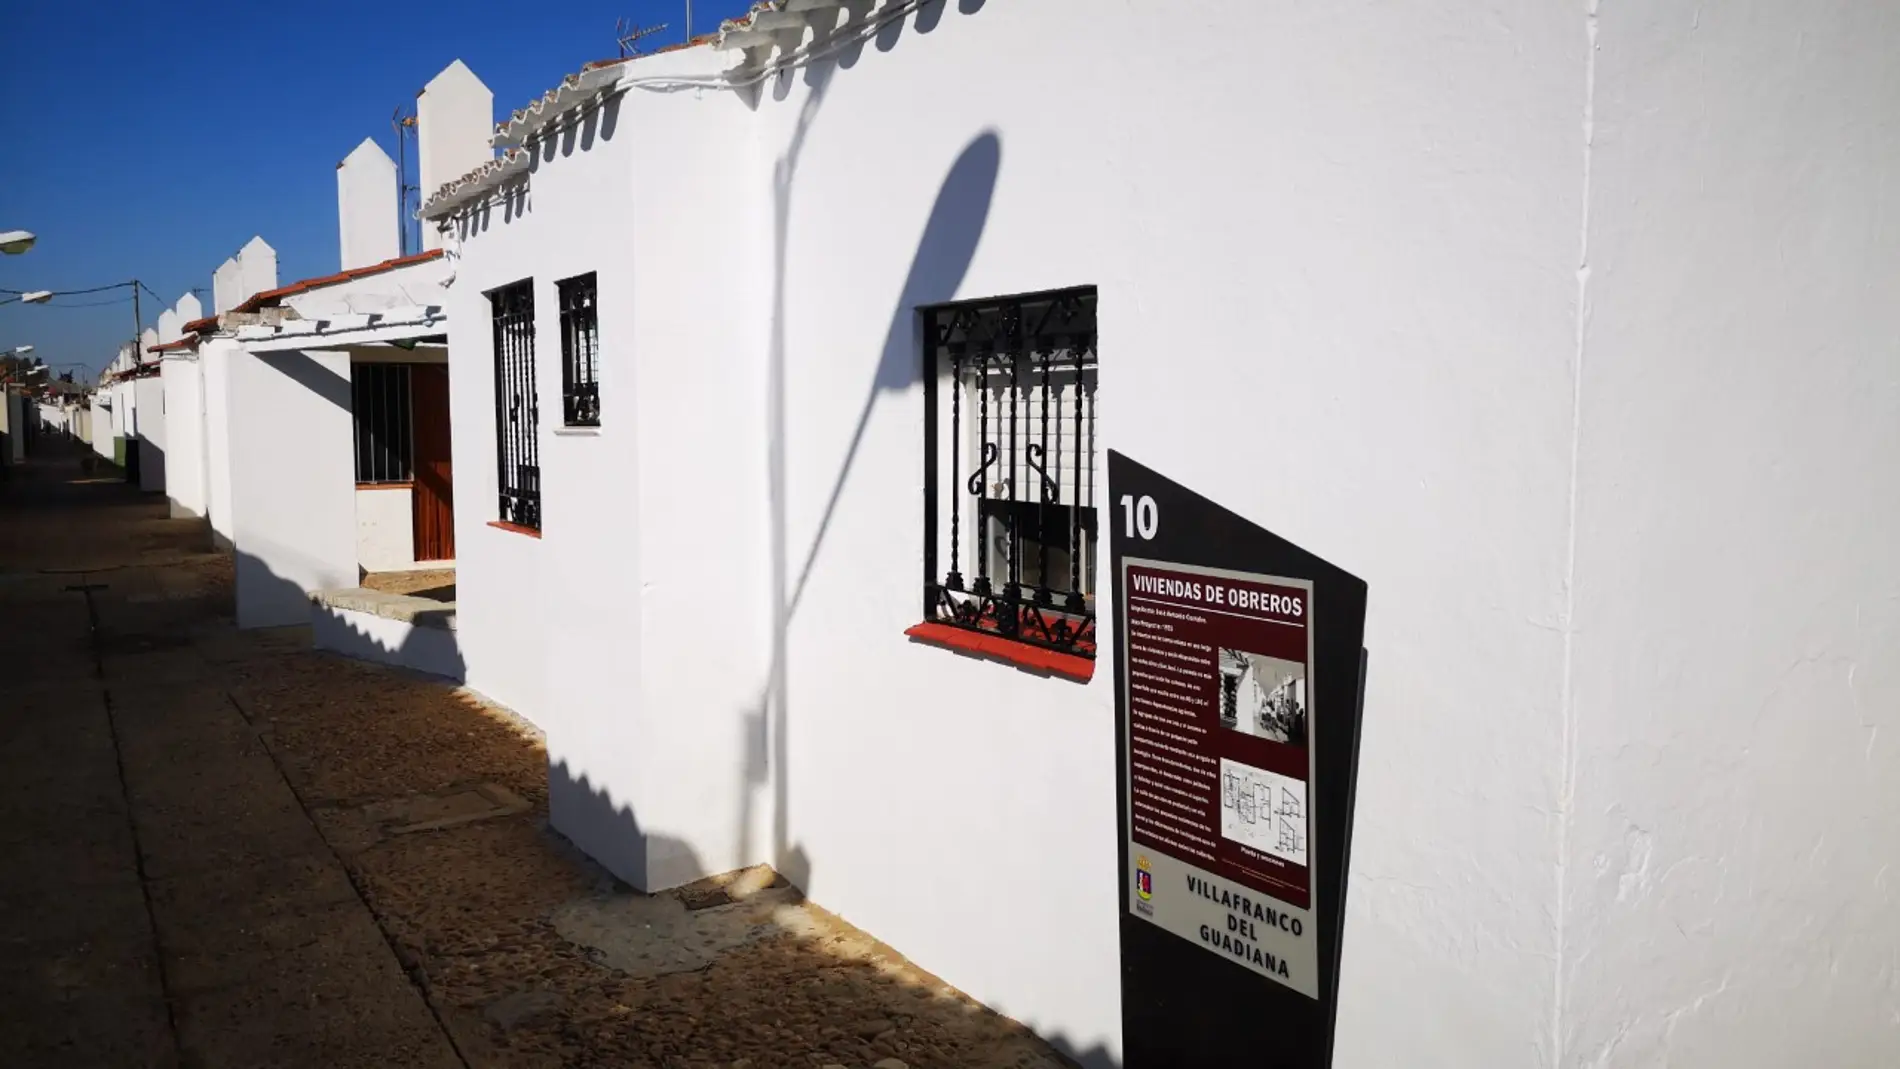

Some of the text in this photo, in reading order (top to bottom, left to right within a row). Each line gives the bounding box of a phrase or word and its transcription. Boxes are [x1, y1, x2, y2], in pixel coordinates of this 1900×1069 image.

[1120, 495, 1158, 540] 10
[1133, 574, 1302, 616] VIVIENDAS DE OBREROS
[1187, 874, 1302, 936] VILLAFRANCO
[1227, 913, 1257, 941] DEL
[1200, 924, 1290, 978] GUADIANA
